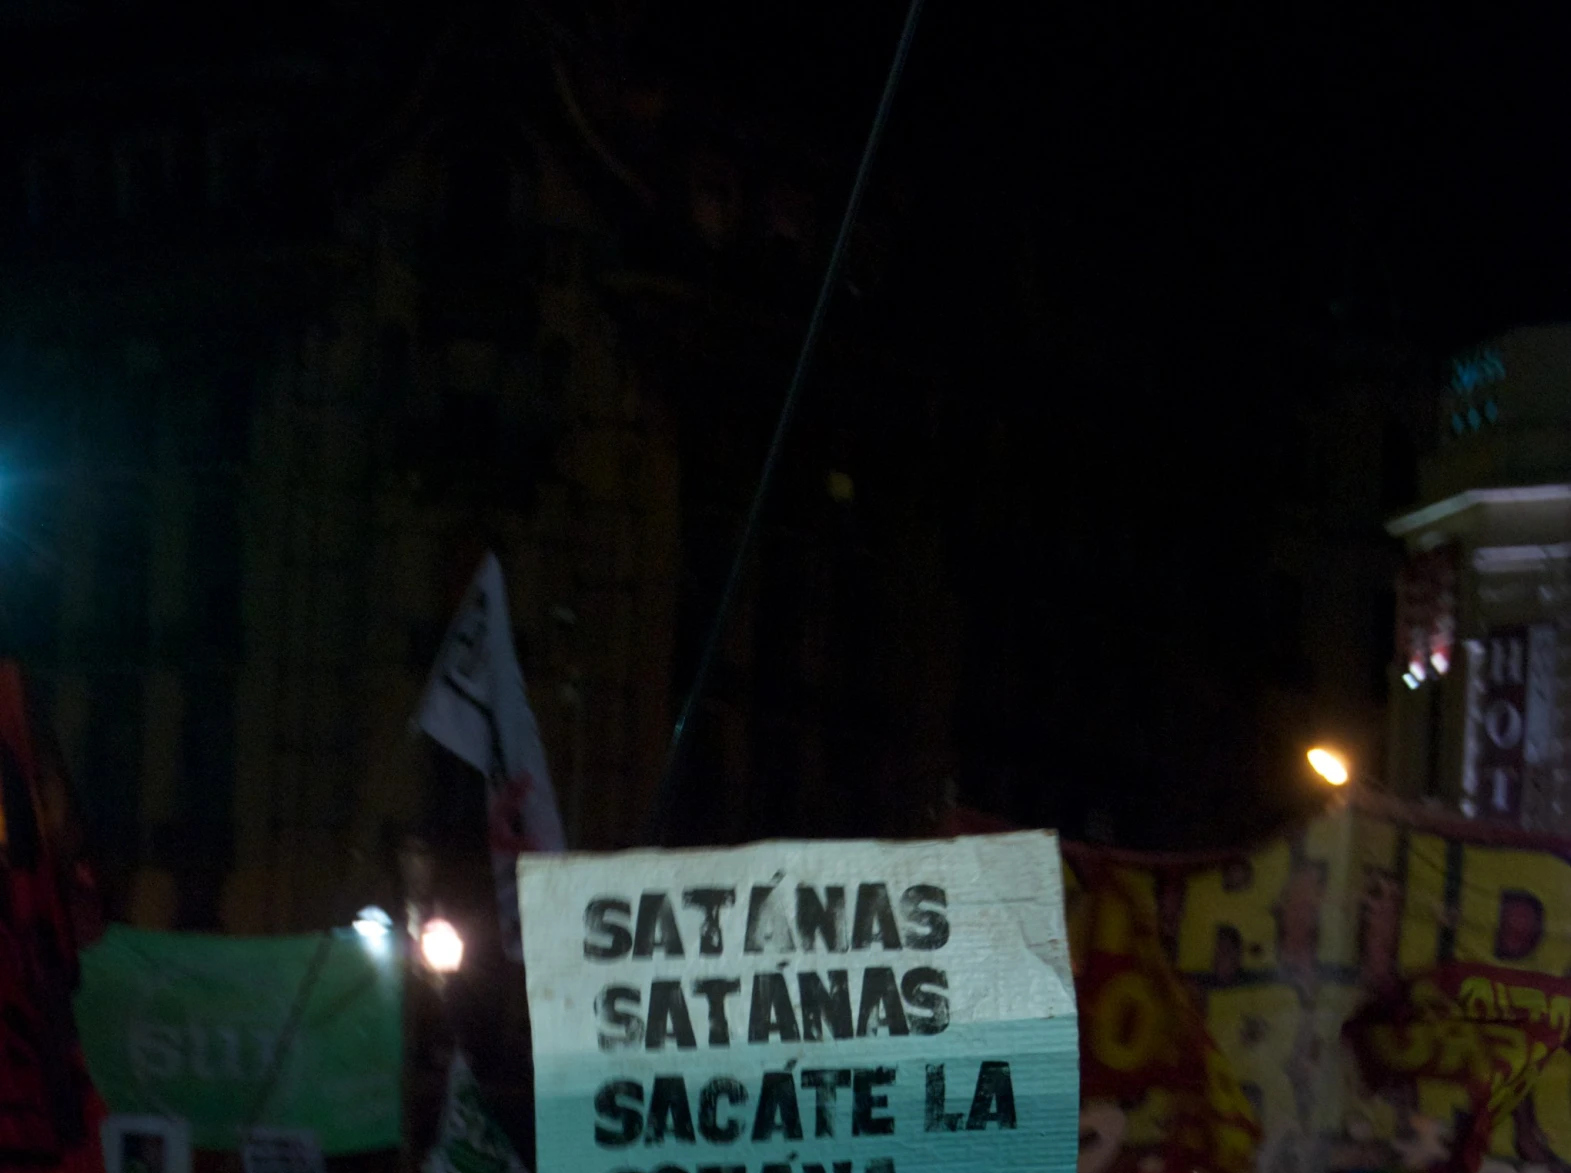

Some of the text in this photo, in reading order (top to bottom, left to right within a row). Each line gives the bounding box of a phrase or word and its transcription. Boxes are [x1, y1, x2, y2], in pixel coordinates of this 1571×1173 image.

[583, 869, 951, 960] SATÁNAS
[594, 961, 951, 1051] SATÁNAS
[594, 1060, 1017, 1147] SACÁTE LA
